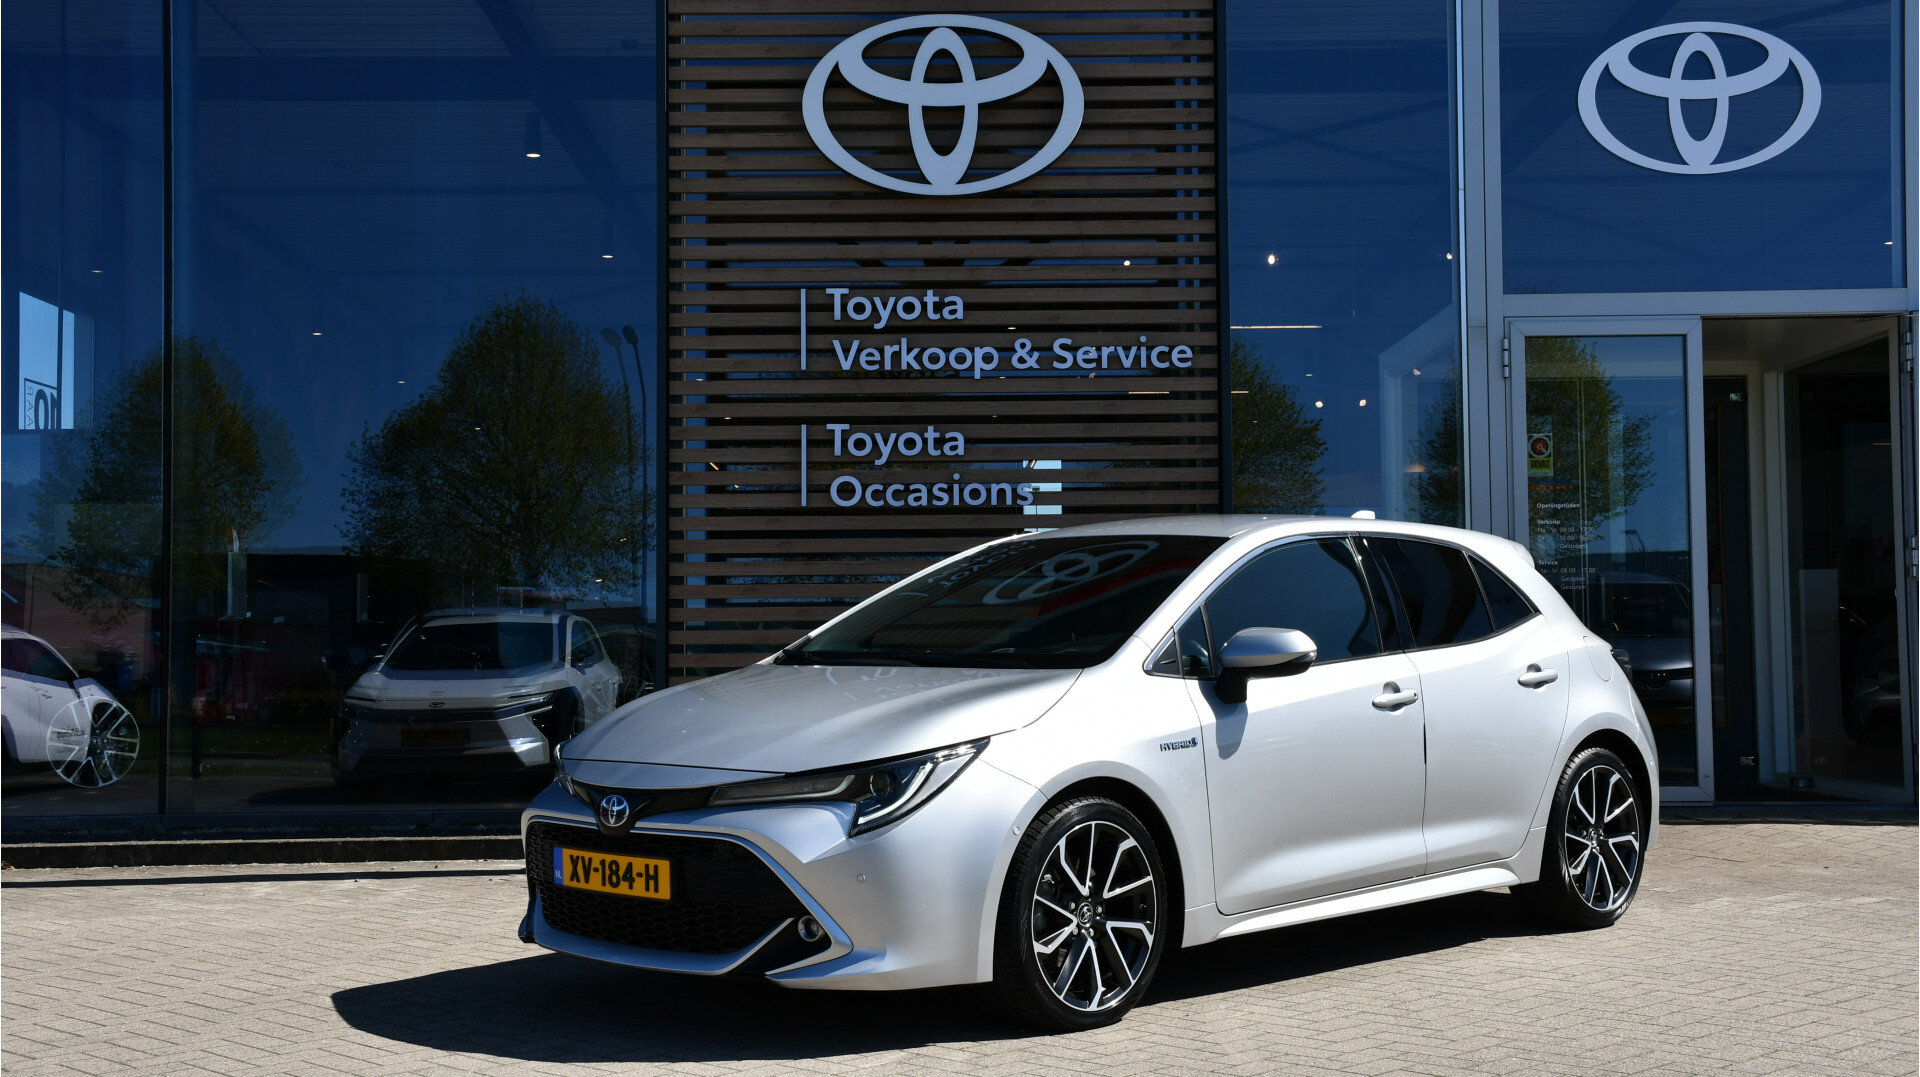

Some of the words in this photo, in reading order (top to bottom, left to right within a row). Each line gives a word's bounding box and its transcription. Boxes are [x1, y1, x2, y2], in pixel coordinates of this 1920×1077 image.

[825, 288, 964, 329] Toyota
[832, 338, 999, 379] Verkoop
[1011, 338, 1040, 369] &
[1052, 335, 1194, 369] Service
[826, 423, 965, 465] Toyota
[830, 473, 1034, 507] Occasions
[1160, 739, 1194, 752] HYBRID
[555, 870, 563, 879] NL
[569, 854, 659, 893] XV-184-H
